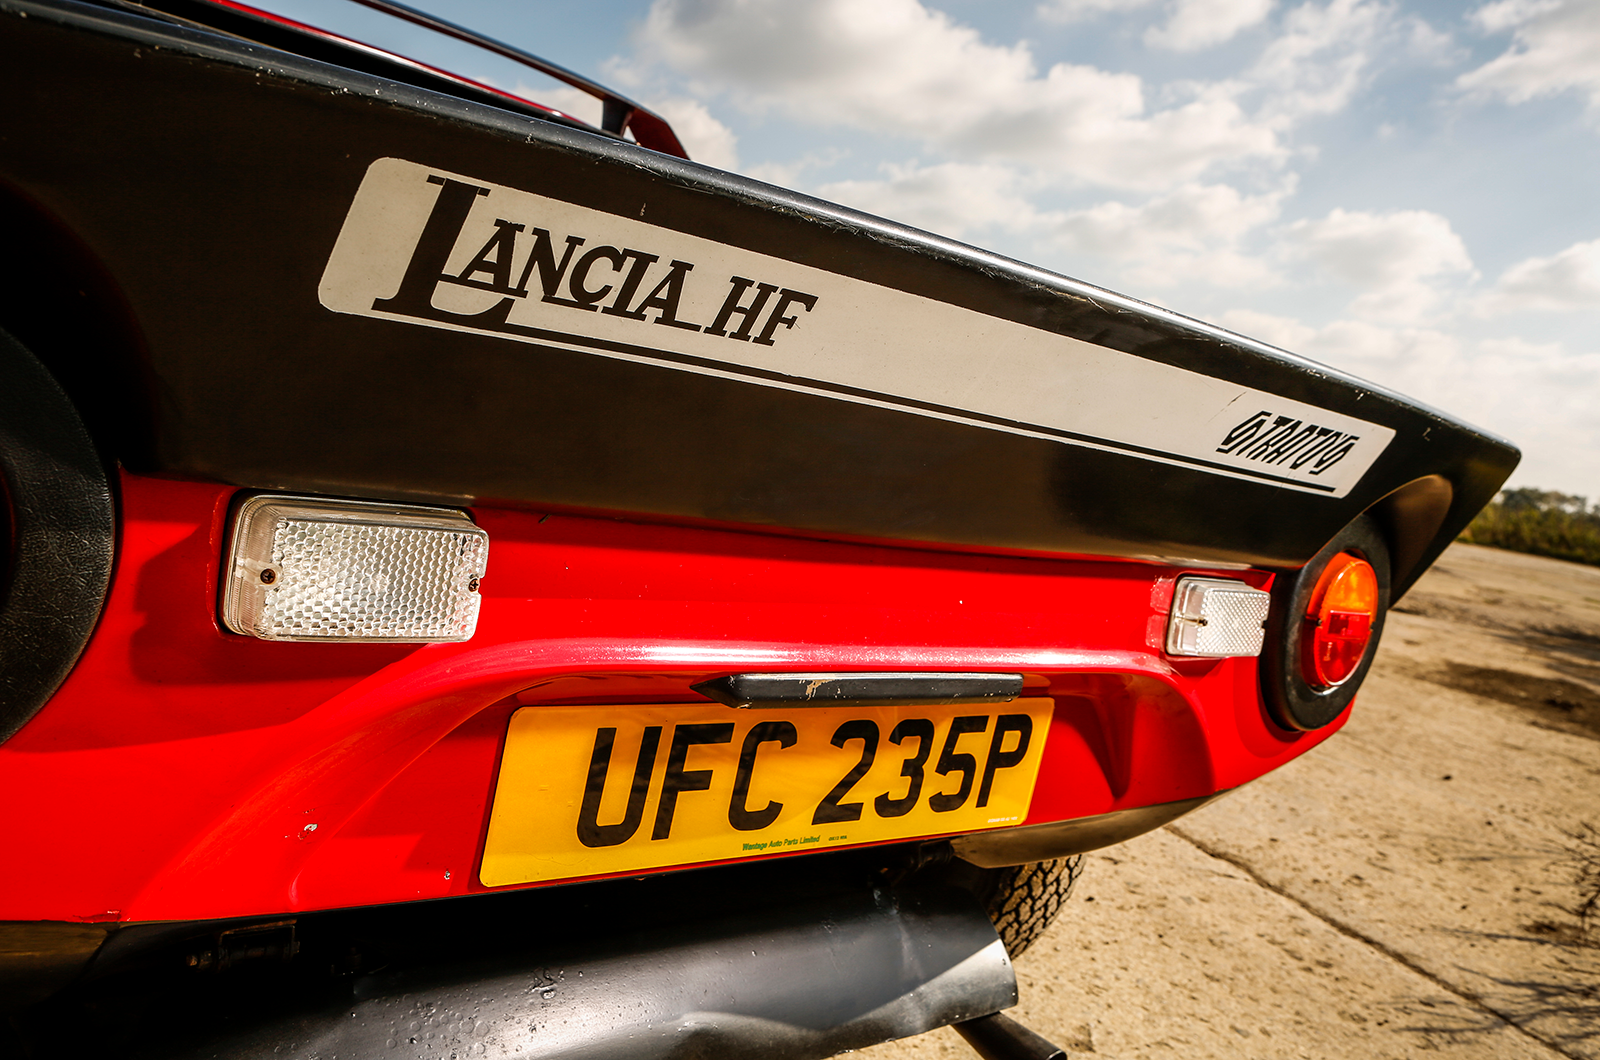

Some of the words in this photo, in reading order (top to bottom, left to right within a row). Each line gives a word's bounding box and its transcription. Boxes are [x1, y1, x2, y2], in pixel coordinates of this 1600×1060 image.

[372, 174, 702, 332] LANCIA
[704, 275, 819, 347] HF
[1215, 410, 1361, 476] STRATOS
[576, 720, 797, 848] UFC
[811, 713, 1034, 826] 235P
[742, 843, 768, 851] Wantage
[768, 840, 783, 848] Auto
[783, 838, 799, 846] Parts
[799, 835, 821, 844] Limited
